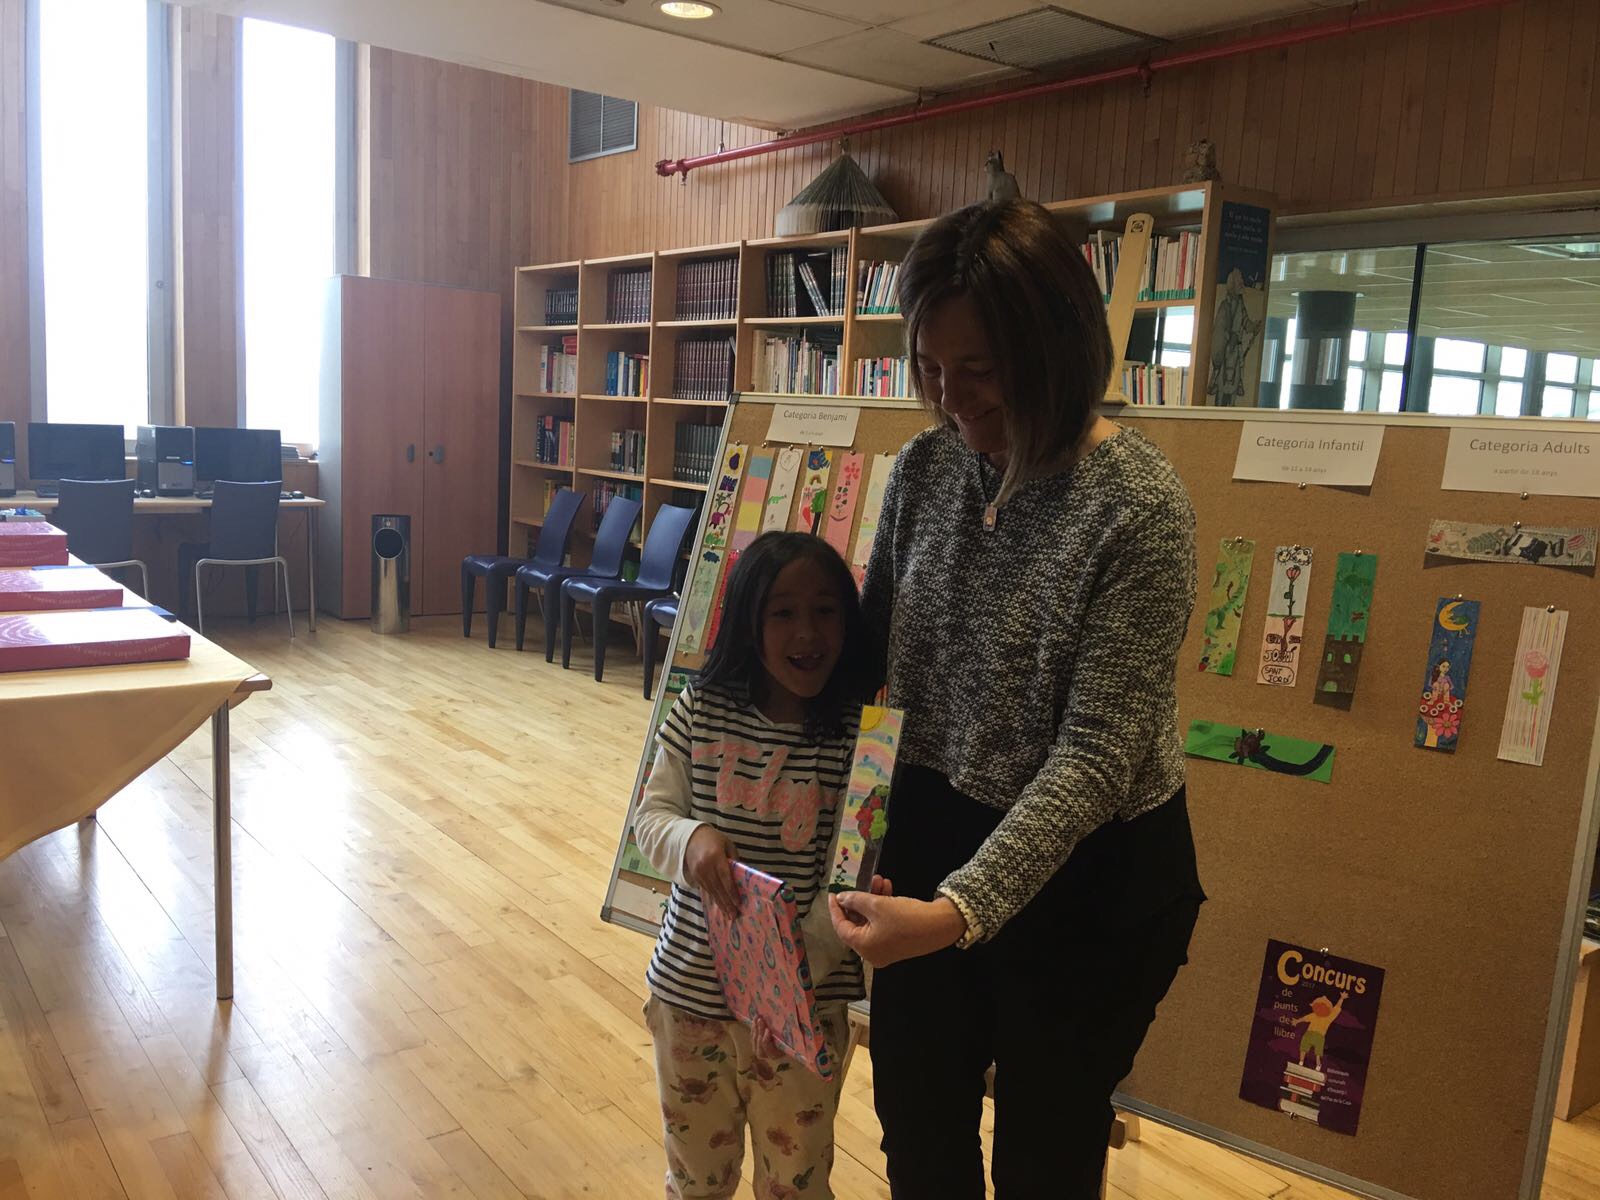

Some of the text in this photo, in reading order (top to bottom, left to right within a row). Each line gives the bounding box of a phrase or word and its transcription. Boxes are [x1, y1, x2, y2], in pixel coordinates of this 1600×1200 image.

[783, 409, 848, 423] Categoria Benjami
[1256, 435, 1365, 452] Categoria Infantil
[1469, 438, 1591, 454] Categoria Adults
[1281, 988, 1293, 998] de
[1273, 1001, 1298, 1012] punts
[1279, 1014, 1291, 1024] de
[1274, 1026, 1296, 1039] llibre
